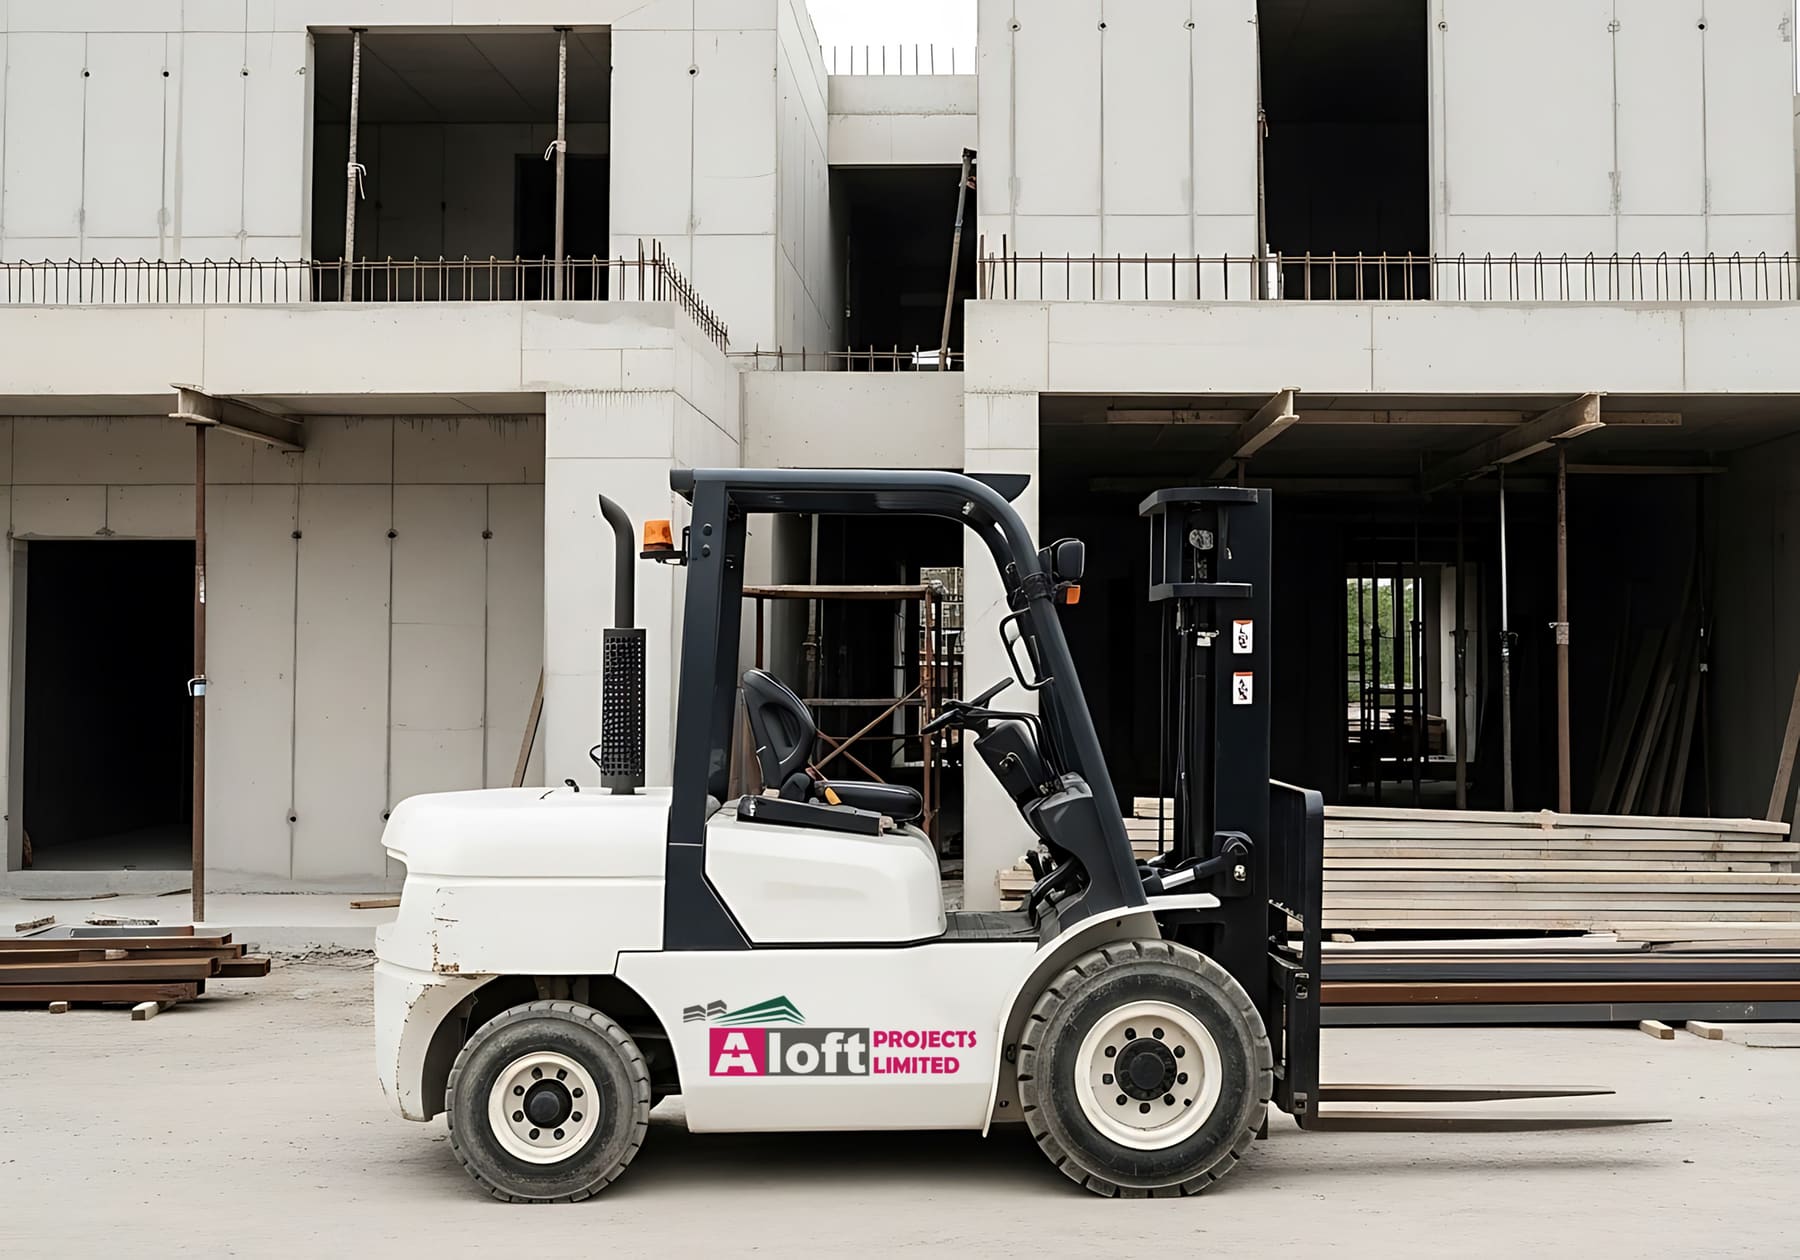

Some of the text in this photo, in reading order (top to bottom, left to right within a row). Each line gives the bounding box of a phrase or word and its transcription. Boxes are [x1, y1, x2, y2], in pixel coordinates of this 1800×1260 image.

[873, 1030, 977, 1050] PROJECTS
[714, 1032, 866, 1074] Aloft
[873, 1057, 960, 1074] LIMITED
